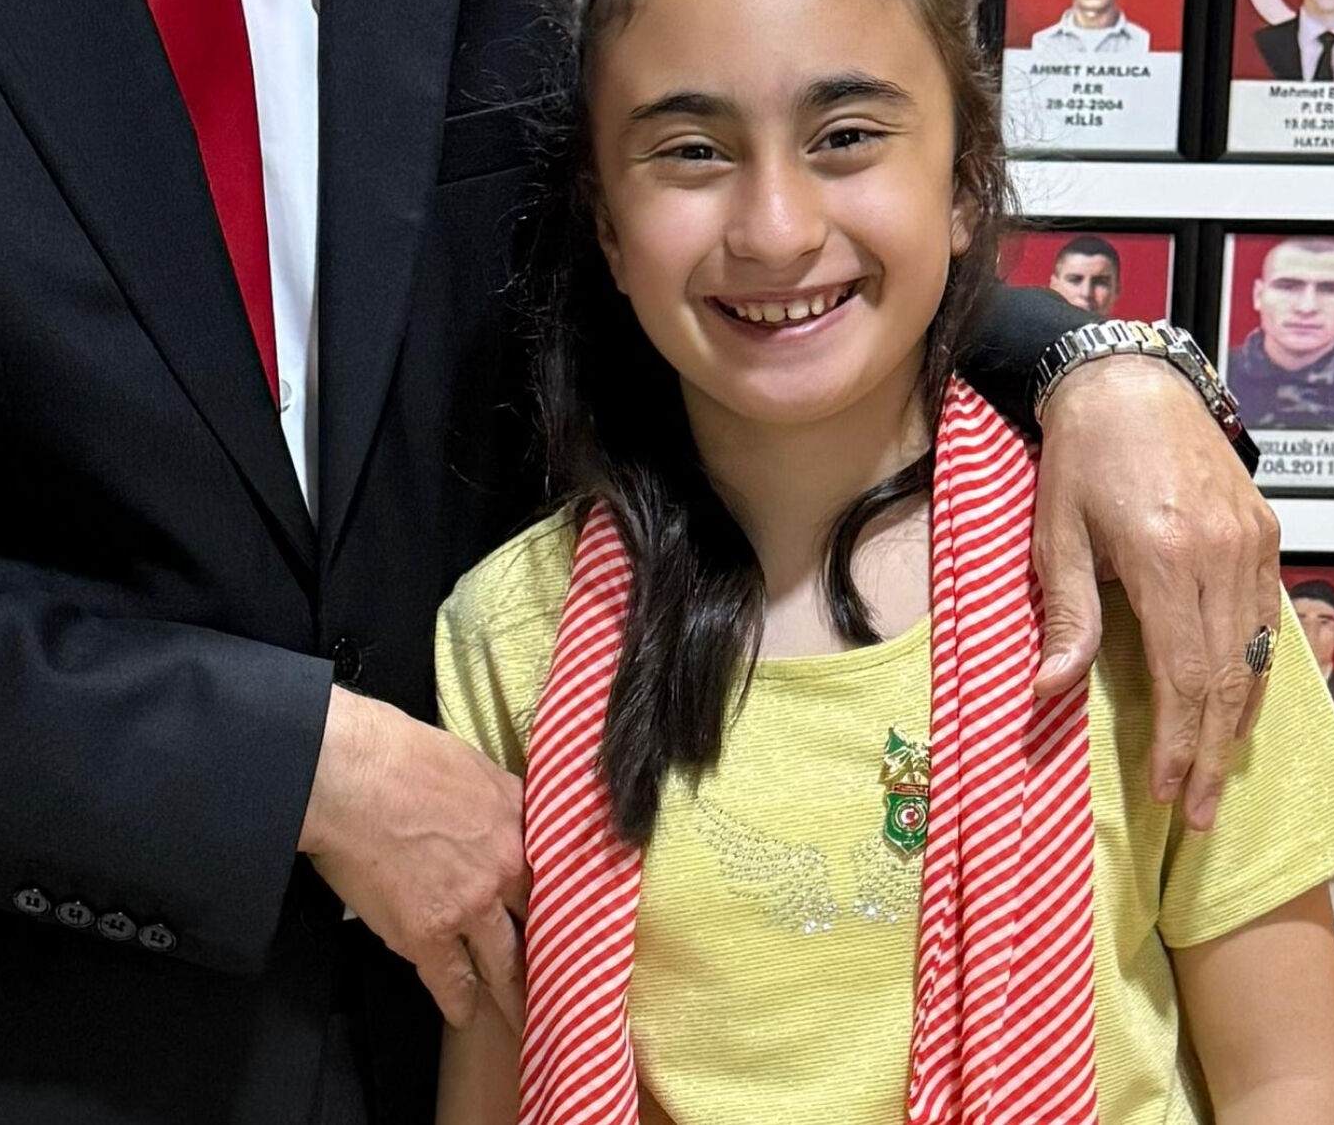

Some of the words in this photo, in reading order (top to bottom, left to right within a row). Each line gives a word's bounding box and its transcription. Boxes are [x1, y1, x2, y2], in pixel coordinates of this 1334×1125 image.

[1030, 64, 1081, 76] AHMET
[1086, 66, 1150, 77] KARLICA
[1269, 86, 1325, 98] Mehmet
